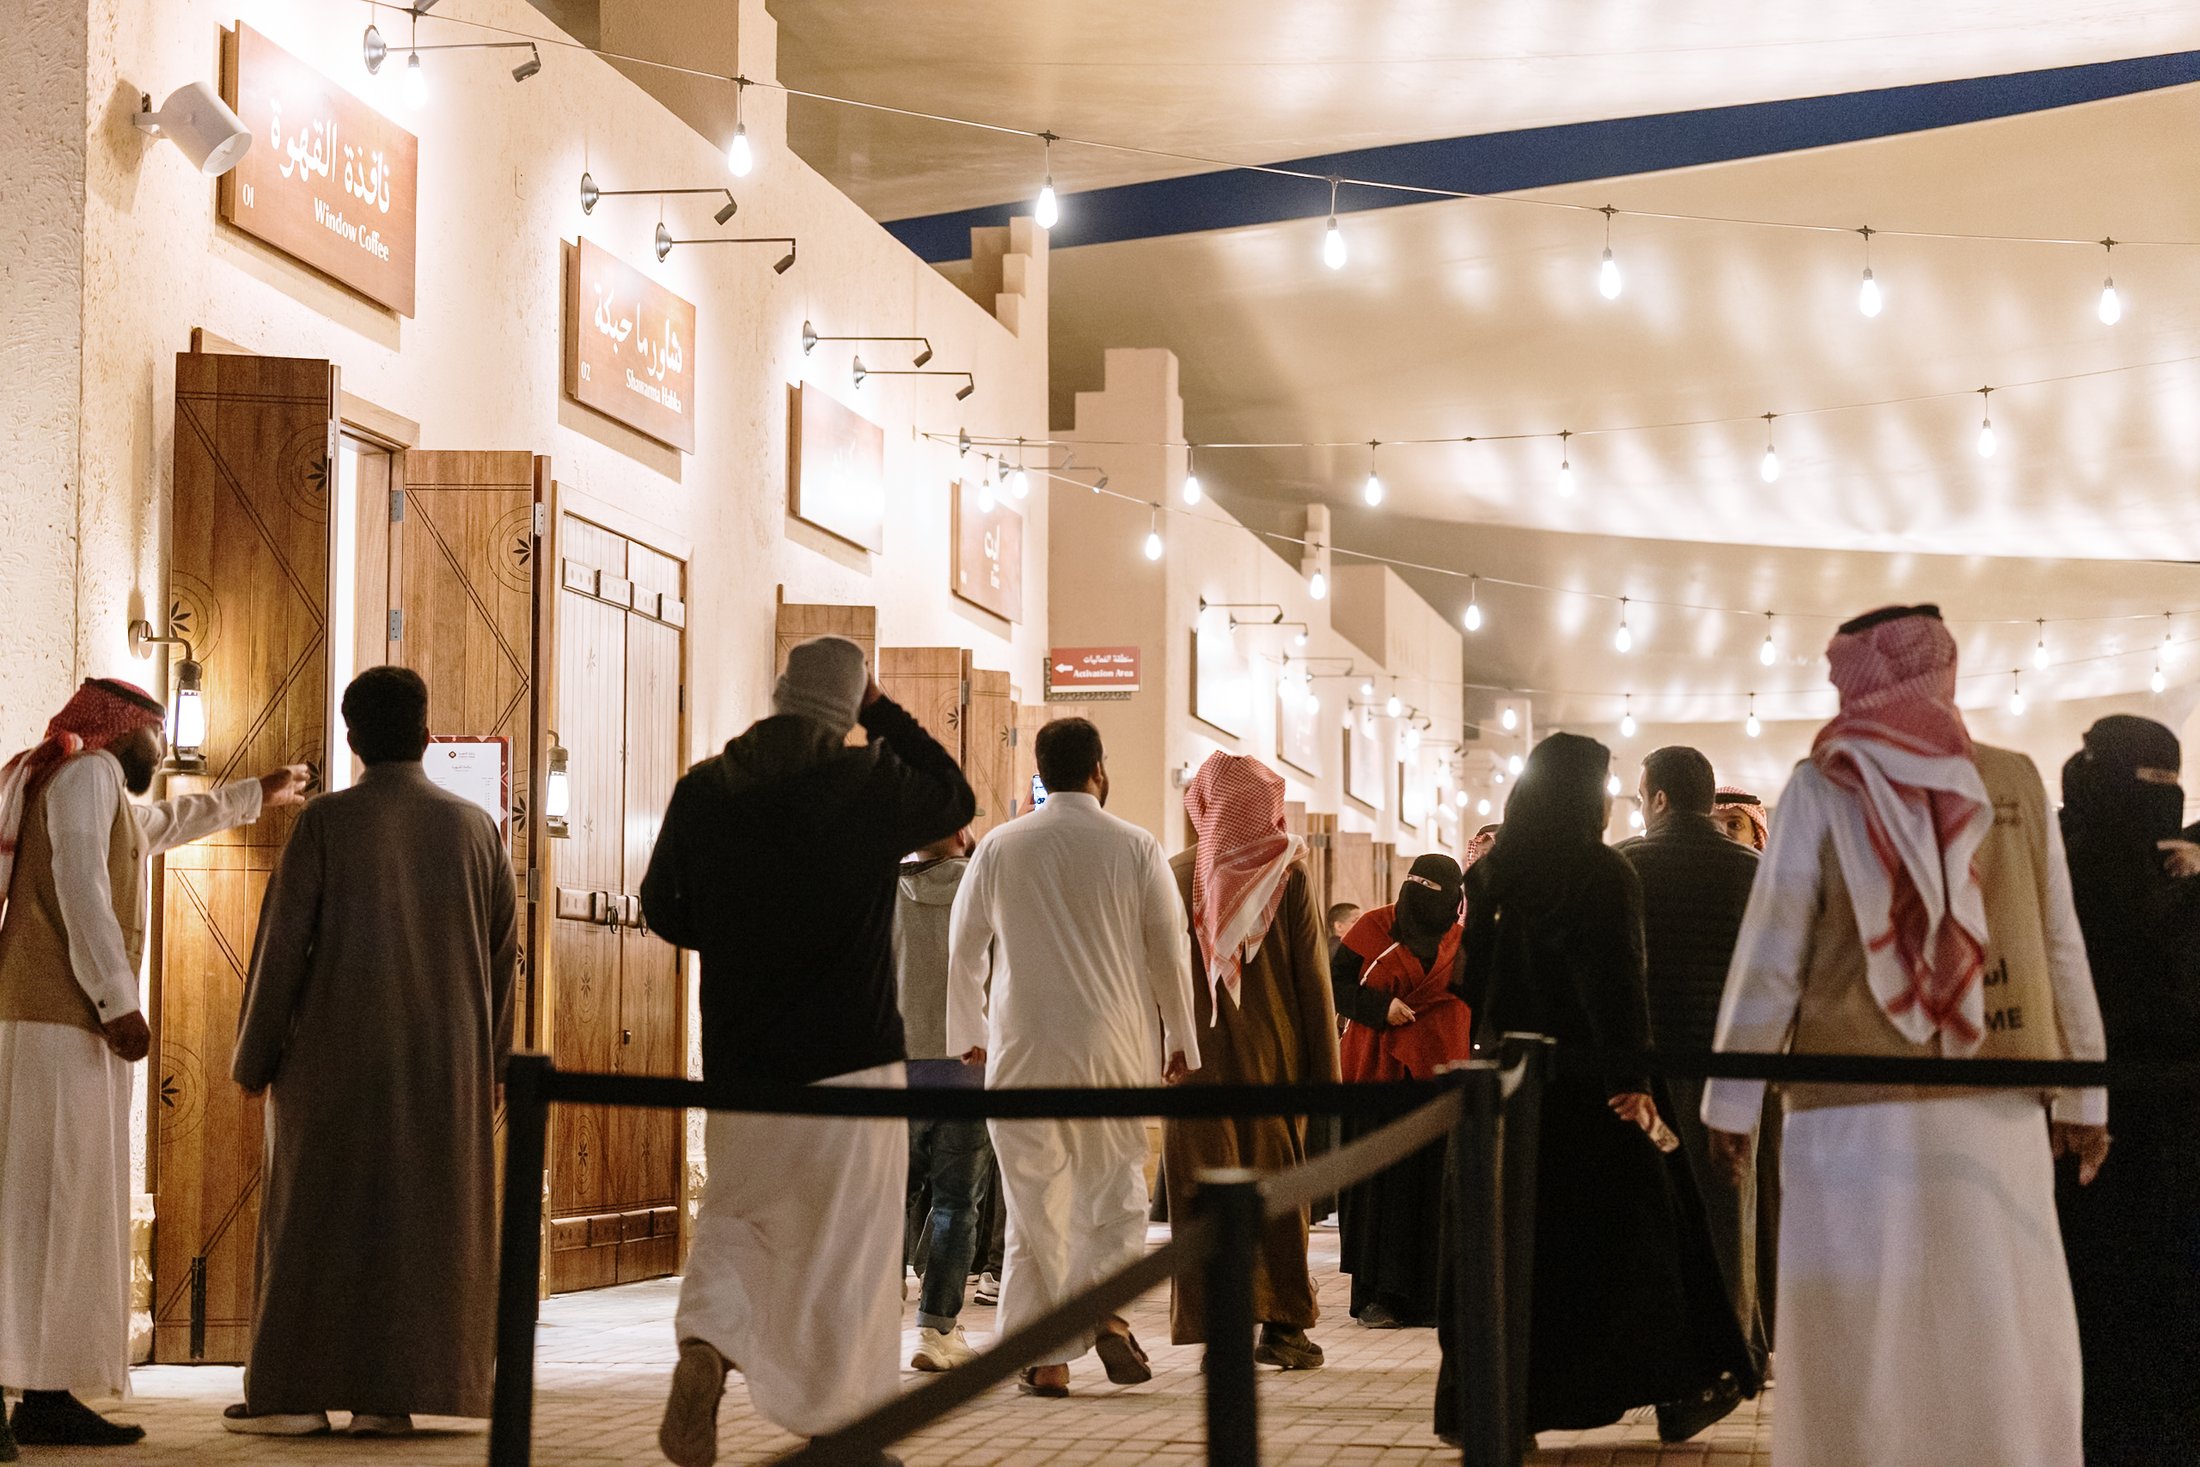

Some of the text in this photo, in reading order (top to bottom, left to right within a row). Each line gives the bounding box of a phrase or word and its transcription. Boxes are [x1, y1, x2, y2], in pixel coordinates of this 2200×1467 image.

[270, 98, 390, 213] نافذة القهوة
[242, 183, 255, 209] 01
[314, 197, 390, 262] Window Coffee
[636, 302, 683, 381] شاورما
[580, 361, 591, 382] 02
[625, 368, 661, 404] Shawarma
[1073, 669, 1134, 678] Activation Area
